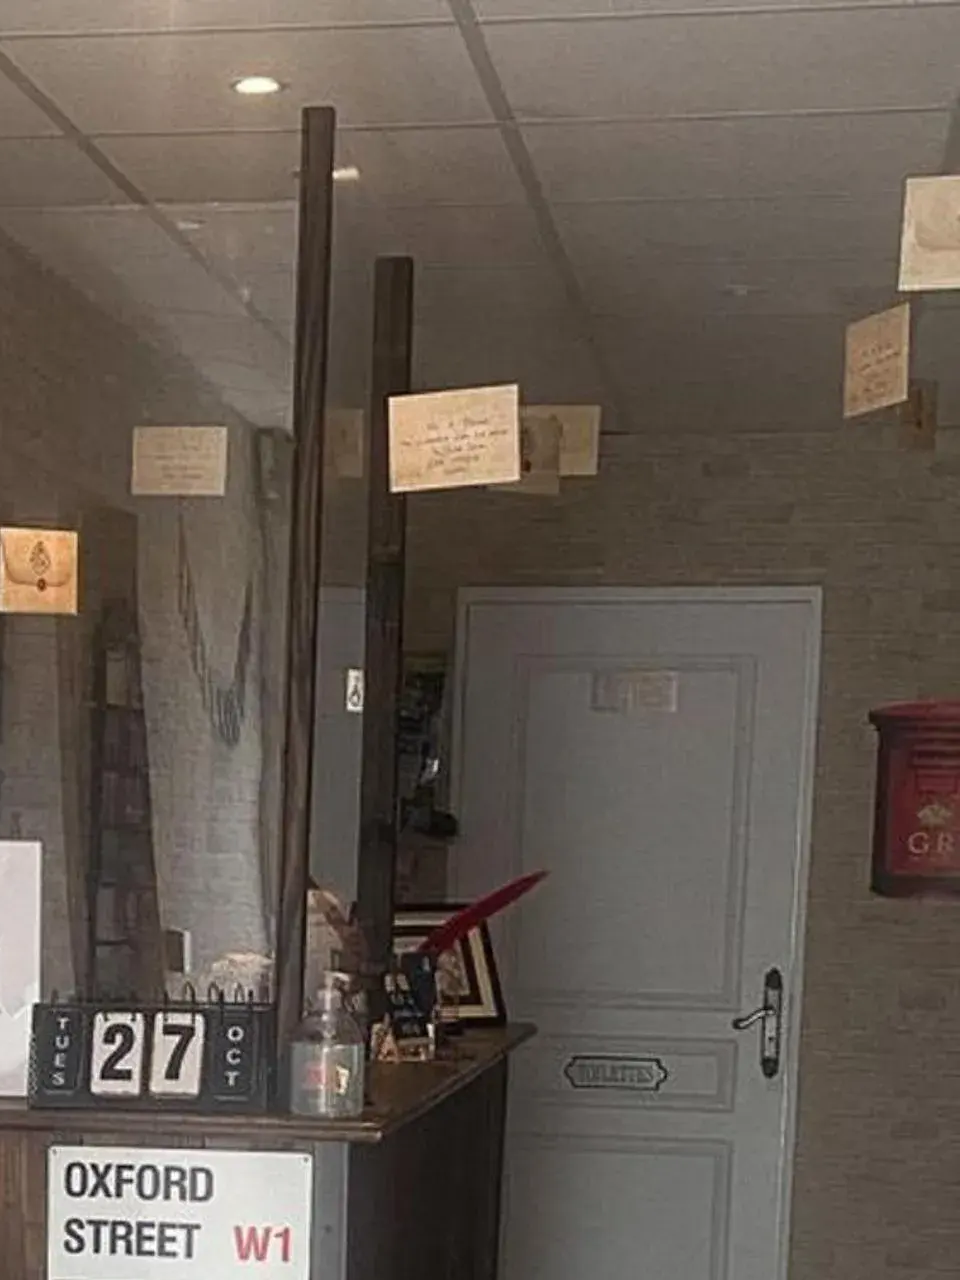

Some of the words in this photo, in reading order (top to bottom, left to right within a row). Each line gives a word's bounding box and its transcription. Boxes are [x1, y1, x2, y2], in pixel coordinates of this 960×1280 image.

[52, 1015, 71, 1087] TUES
[226, 1024, 245, 1088] OCT
[63, 1161, 214, 1203] OXFORD
[62, 1218, 202, 1259] STREET
[233, 1225, 292, 1263] W1
